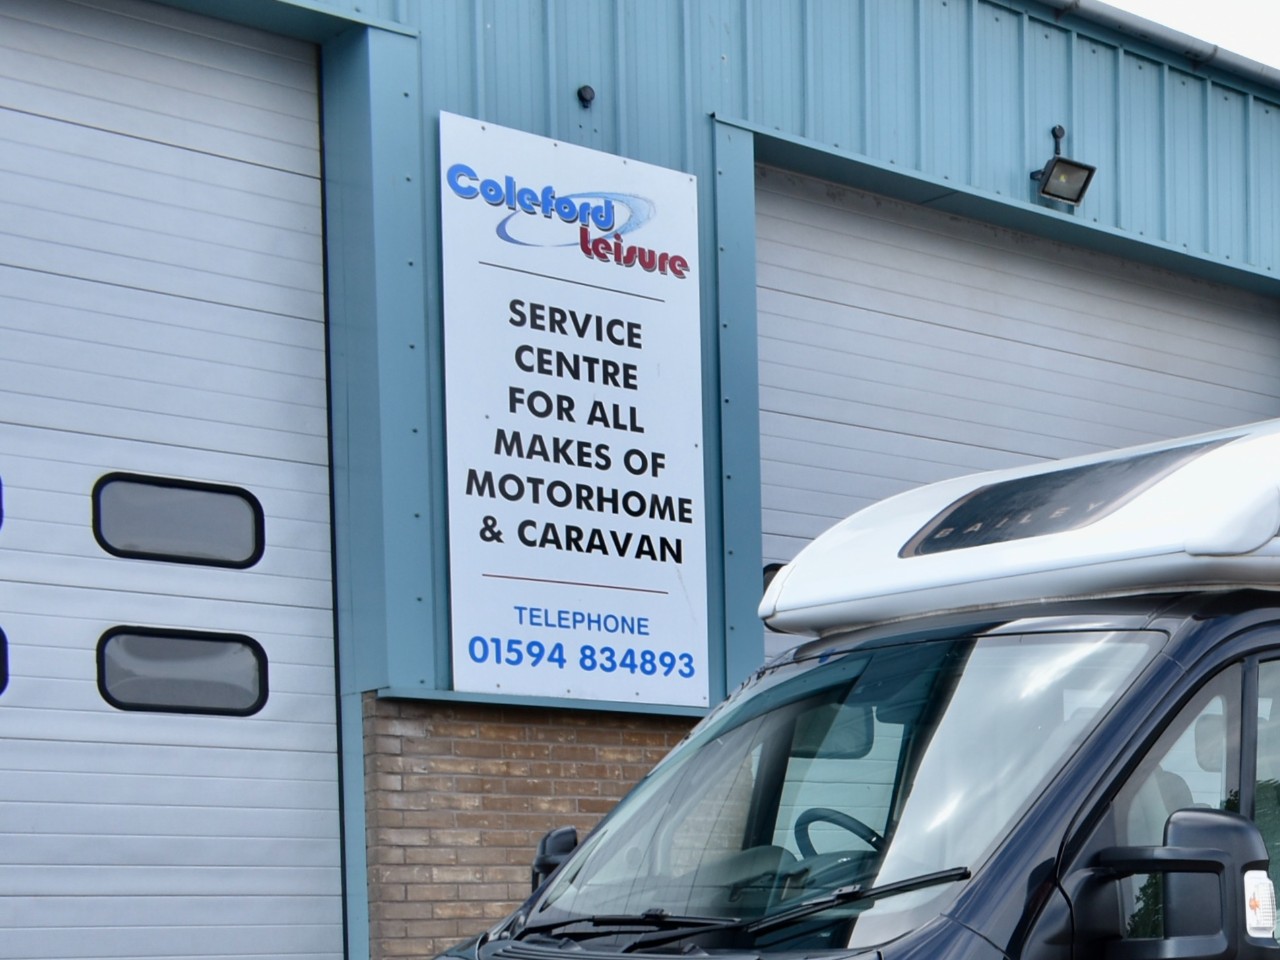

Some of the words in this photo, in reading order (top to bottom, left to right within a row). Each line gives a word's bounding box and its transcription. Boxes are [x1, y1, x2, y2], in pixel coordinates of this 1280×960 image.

[446, 163, 615, 231] Coleford
[579, 226, 690, 279] Leisure
[508, 298, 642, 349] SERVICE
[514, 344, 638, 390] CENTRE
[508, 386, 576, 423] FOR
[586, 400, 645, 434] ALL
[494, 428, 612, 471] MAKES
[623, 448, 666, 478] OF
[465, 468, 693, 523] MOTORHOME
[933, 500, 1106, 539] BAILEY
[479, 515, 504, 543] &
[517, 519, 683, 564] CARAVAN
[513, 605, 650, 636] TELEPHONE
[468, 636, 567, 669] 01594
[579, 644, 695, 678] 834893
